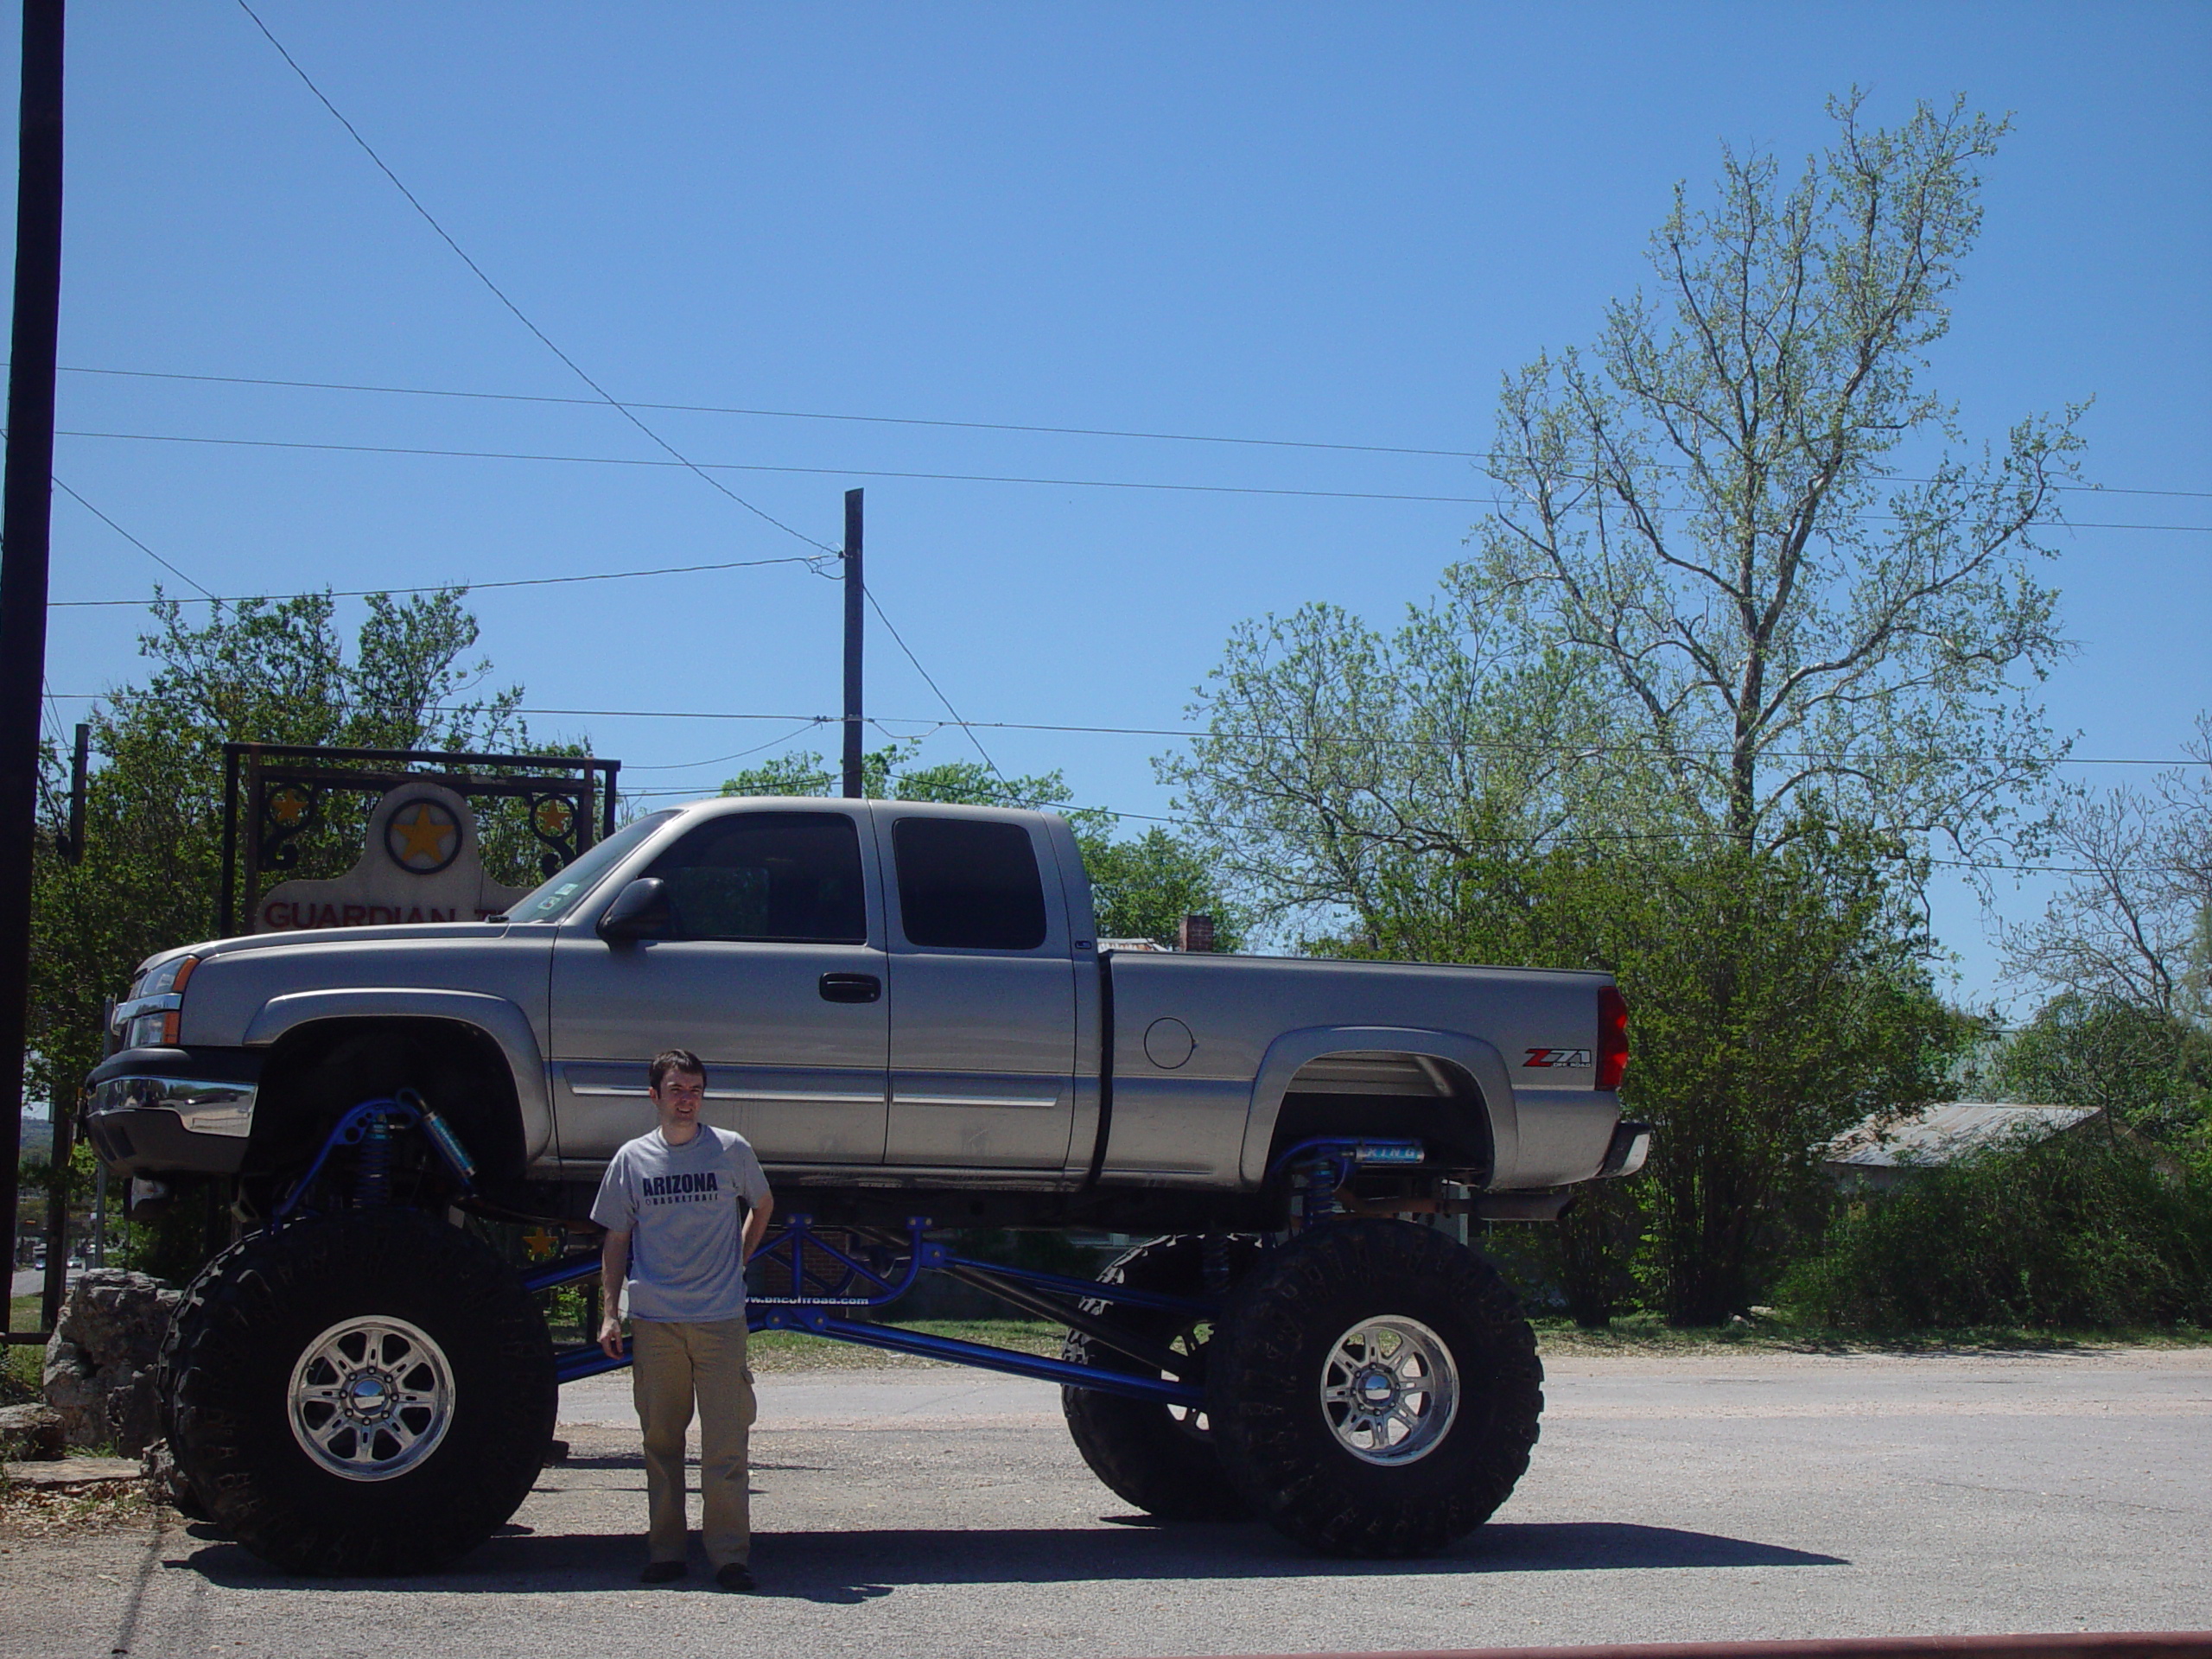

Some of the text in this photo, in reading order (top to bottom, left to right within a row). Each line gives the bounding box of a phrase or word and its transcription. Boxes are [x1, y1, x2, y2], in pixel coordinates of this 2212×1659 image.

[264, 902, 456, 929] GUARDIAN
[1522, 1048, 1592, 1067] Z71
[643, 1173, 718, 1197] ARIZONA
[653, 1193, 718, 1205] BASKETBALL
